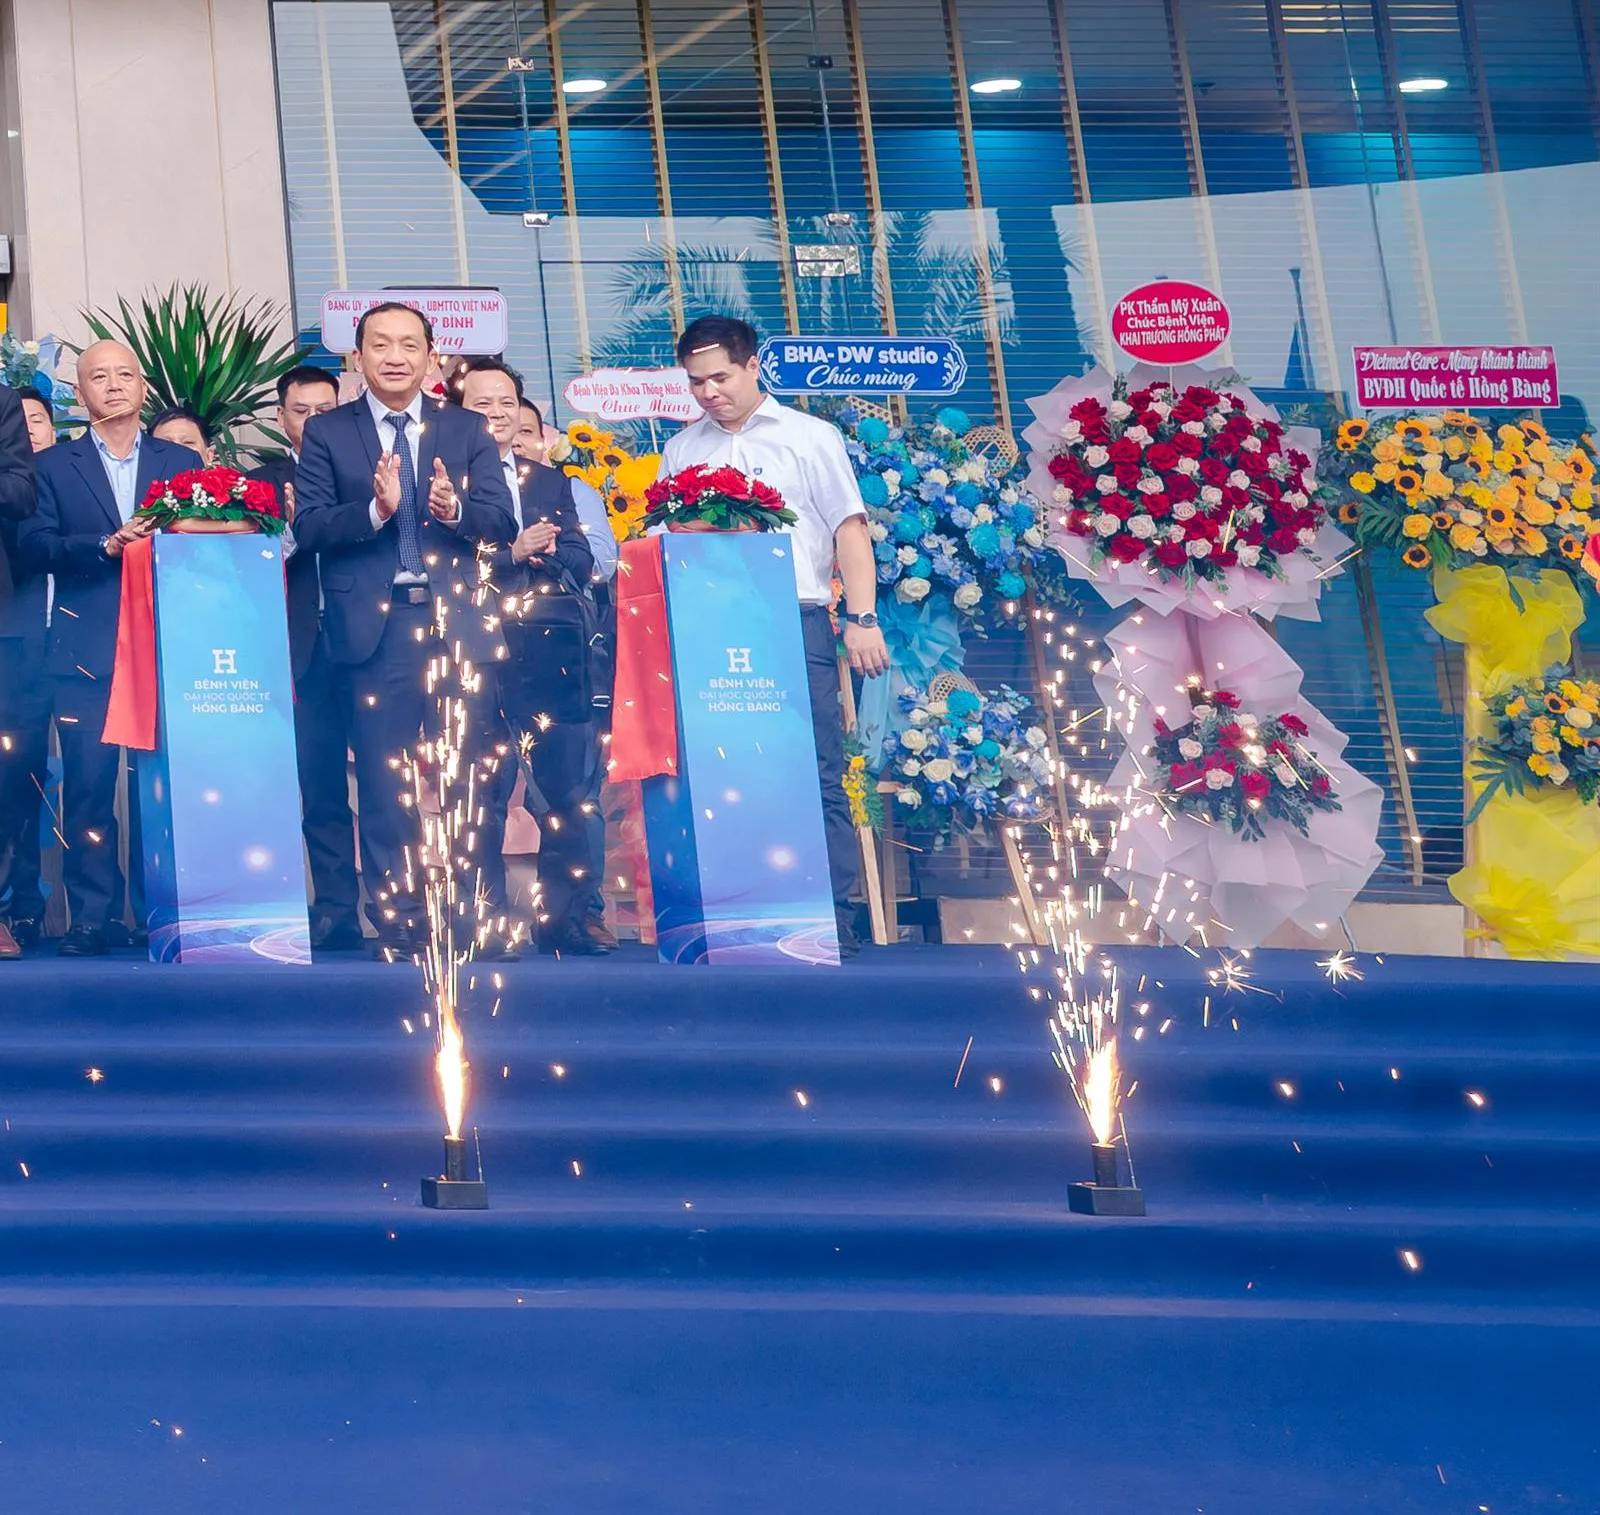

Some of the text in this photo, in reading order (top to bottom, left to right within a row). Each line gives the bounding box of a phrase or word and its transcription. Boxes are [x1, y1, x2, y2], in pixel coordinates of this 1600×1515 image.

[427, 300, 460, 312] UBMTTQ
[480, 301, 499, 311] NAM
[1120, 297, 1221, 317] PK Thẩm Mỹ Xuân
[1127, 316, 1157, 329] Chúc
[1157, 315, 1187, 330] Bệnh
[1120, 331, 1141, 346] KHAI
[838, 346, 874, 363] DW
[878, 346, 939, 364] studio
[1480, 350, 1514, 370] khánh
[1516, 350, 1548, 370] thành
[805, 364, 919, 390] Chúc mừng
[1363, 375, 1552, 404] BVĐH Quốc tế Hồng Bàng
[212, 649, 237, 674] H
[726, 648, 752, 673] H
